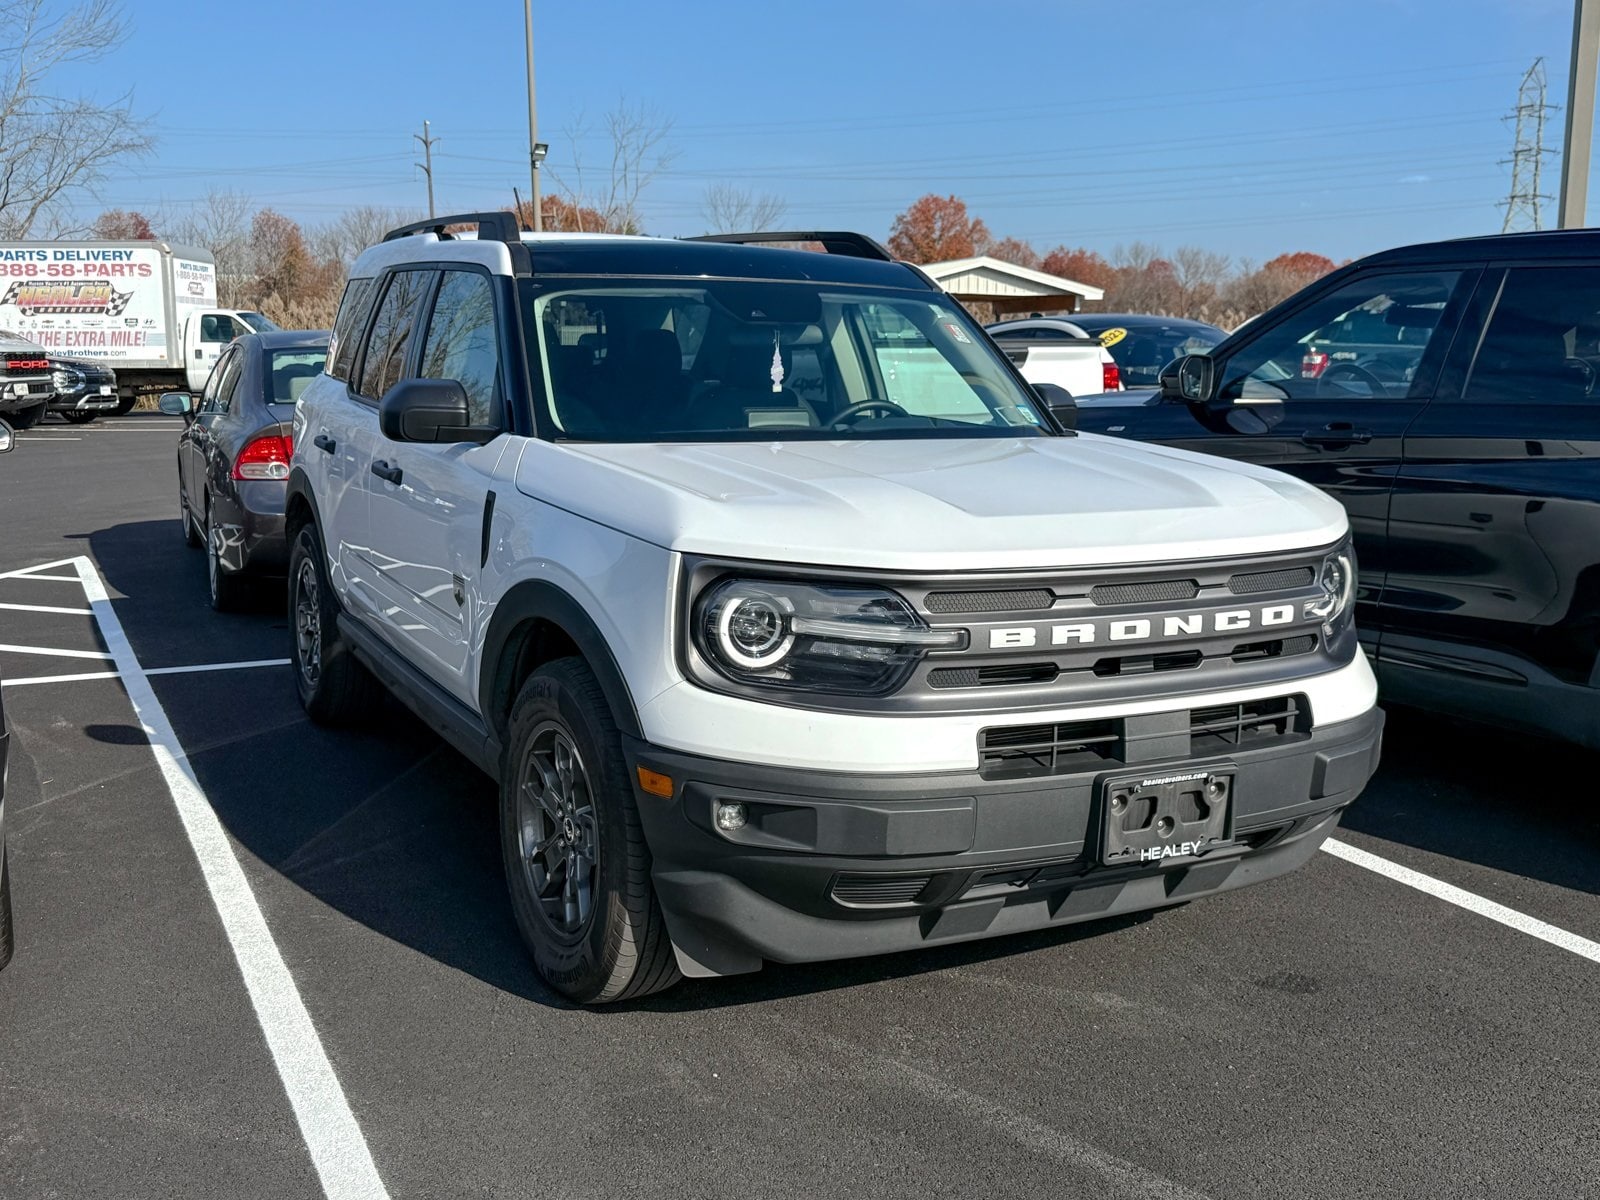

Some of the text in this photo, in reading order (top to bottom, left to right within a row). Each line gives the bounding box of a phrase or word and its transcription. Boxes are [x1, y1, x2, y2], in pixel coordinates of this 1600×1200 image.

[53, 250, 134, 261] DELIVERY
[17, 285, 112, 306] HEALEY
[37, 330, 61, 346] THE
[65, 330, 106, 346] EXTRA
[110, 330, 147, 346] MILE!
[7, 360, 50, 368] FORD
[988, 604, 1295, 649] BRONCO
[1142, 772, 1209, 787] healeybrothers.com
[1139, 840, 1202, 862] HEALEY
